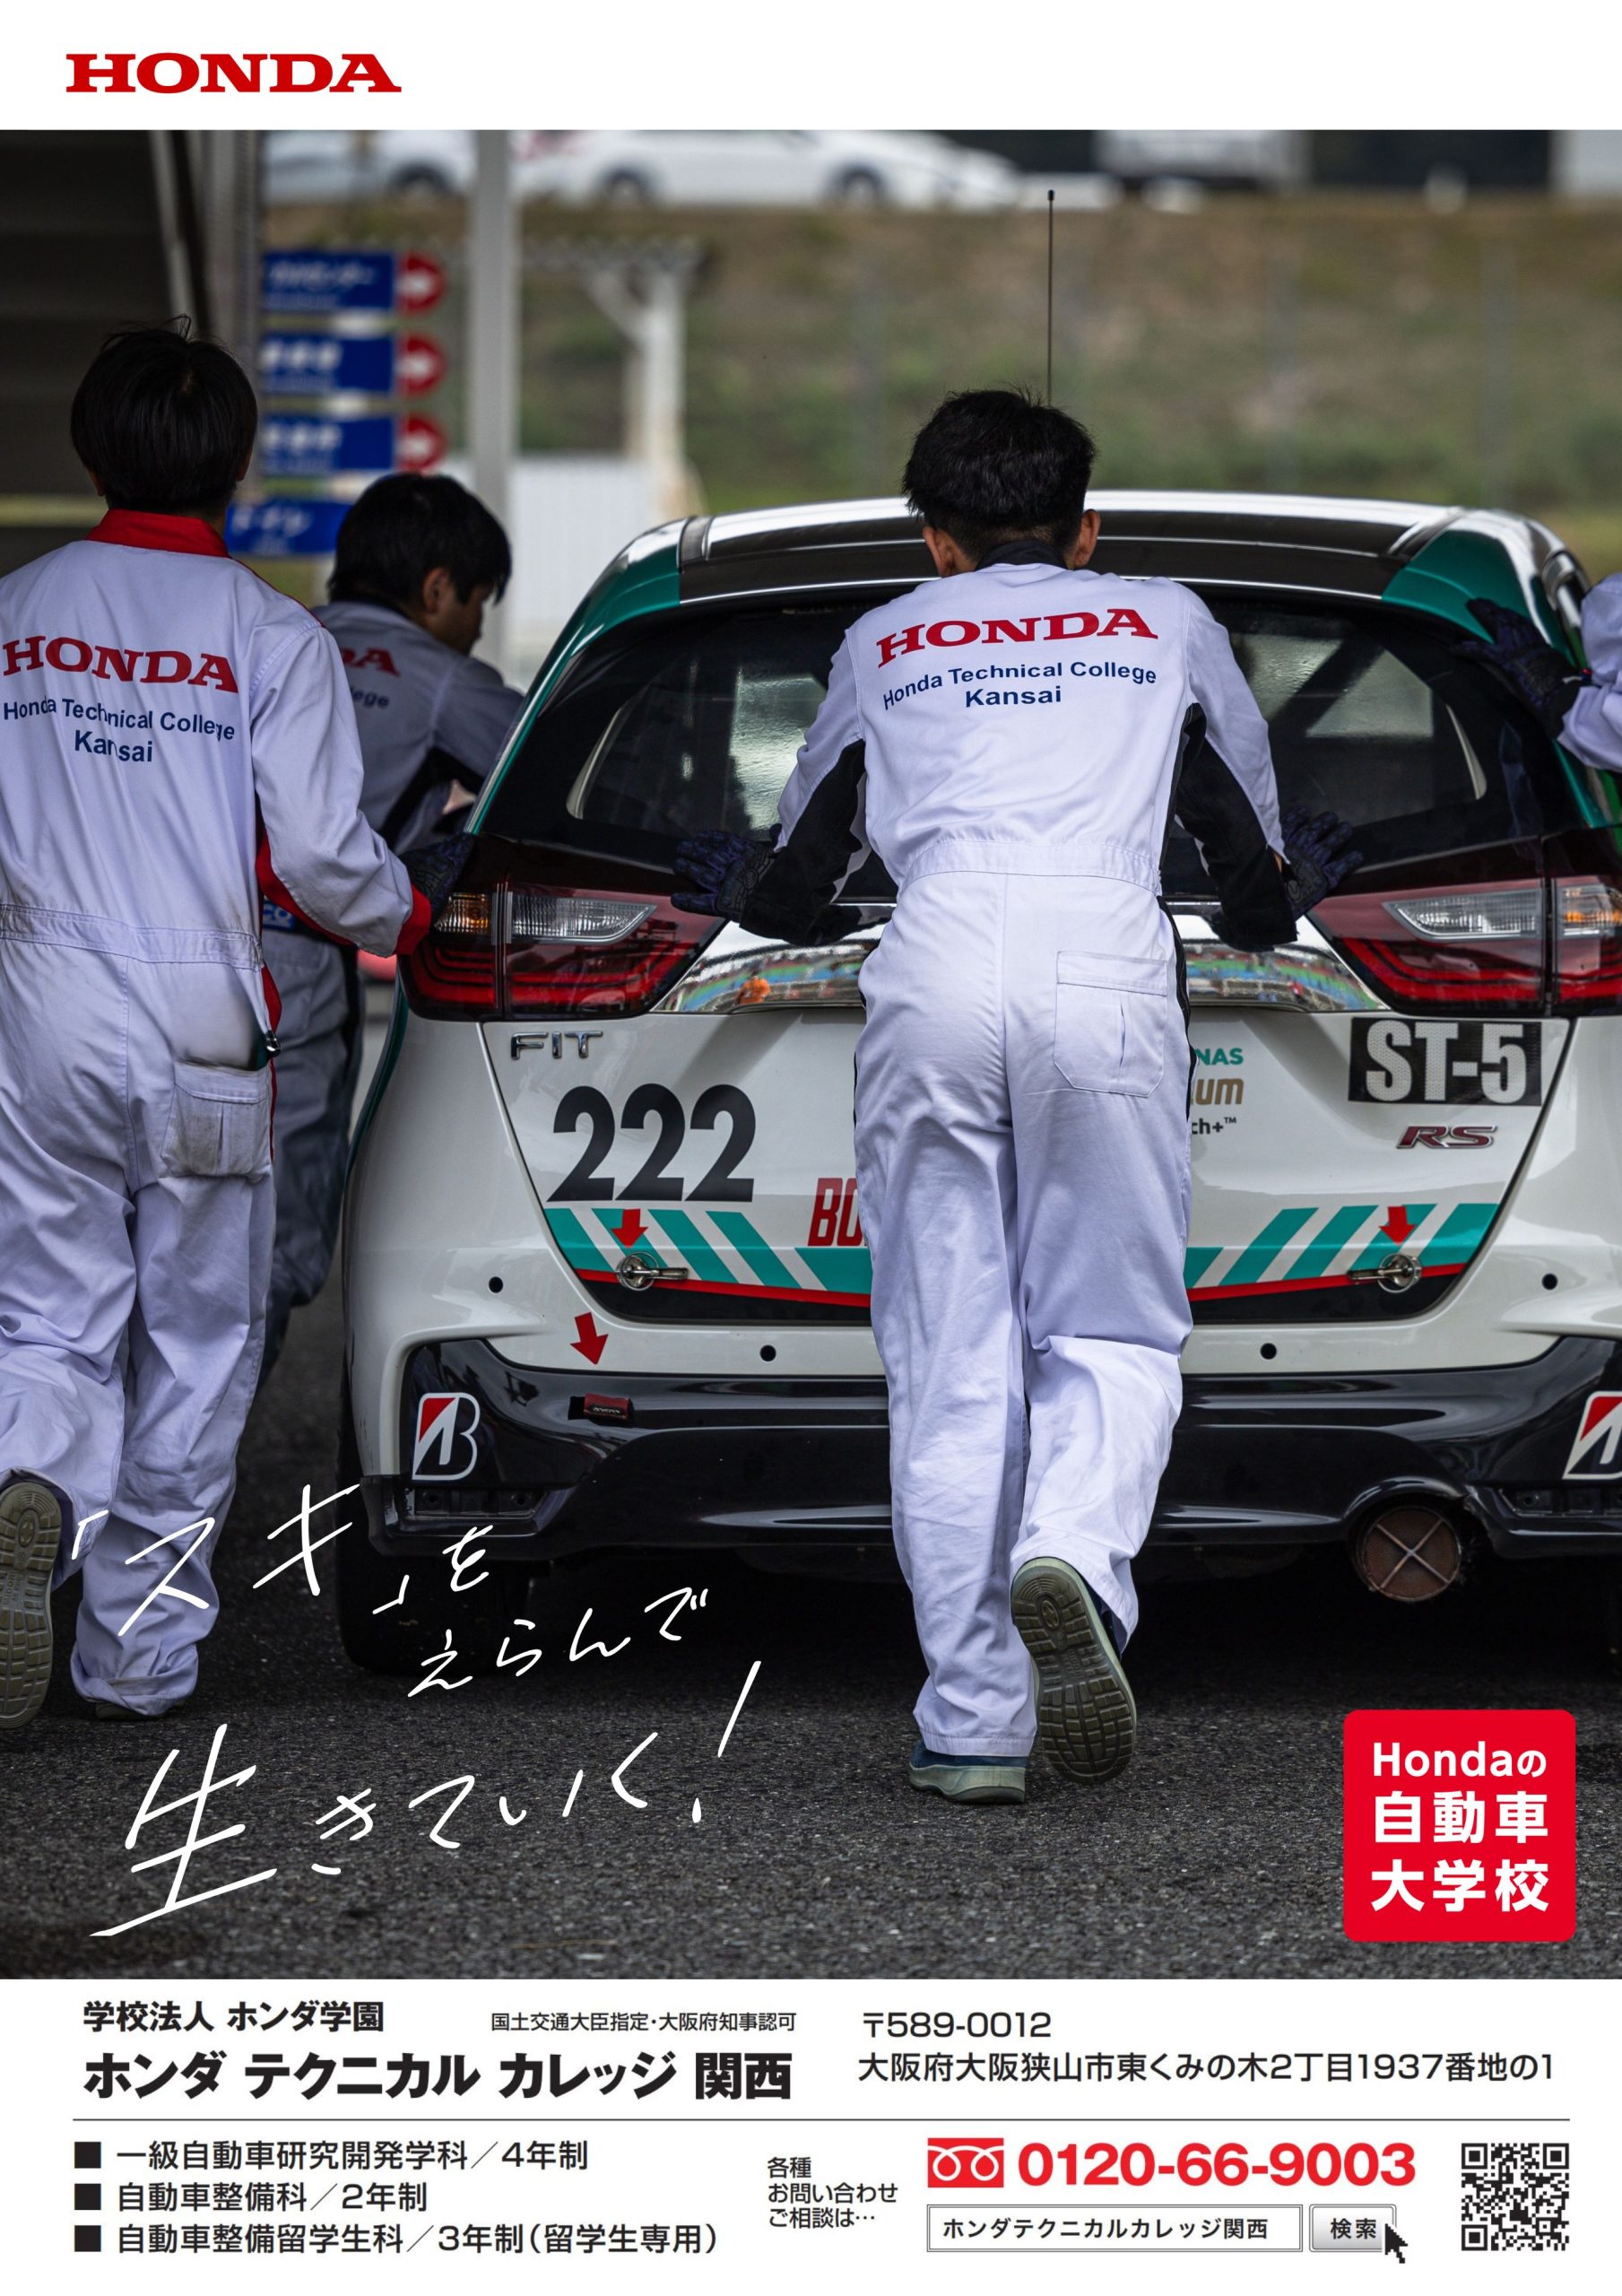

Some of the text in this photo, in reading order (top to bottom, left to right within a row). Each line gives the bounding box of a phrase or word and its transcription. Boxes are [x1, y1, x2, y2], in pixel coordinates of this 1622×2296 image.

[876, 608, 1159, 668] HONDA
[2, 635, 239, 694] HONDA
[882, 661, 1157, 710] Honda Technical College
[966, 686, 1062, 708] Kansai
[4, 696, 56, 720] Honda
[62, 698, 153, 729] Technical
[74, 729, 152, 762] Kansai
[511, 1031, 603, 1060] FIT
[1366, 1019, 1527, 1104] ST-5
[546, 1083, 756, 1203] 222
[1396, 1125, 1498, 1150] RS
